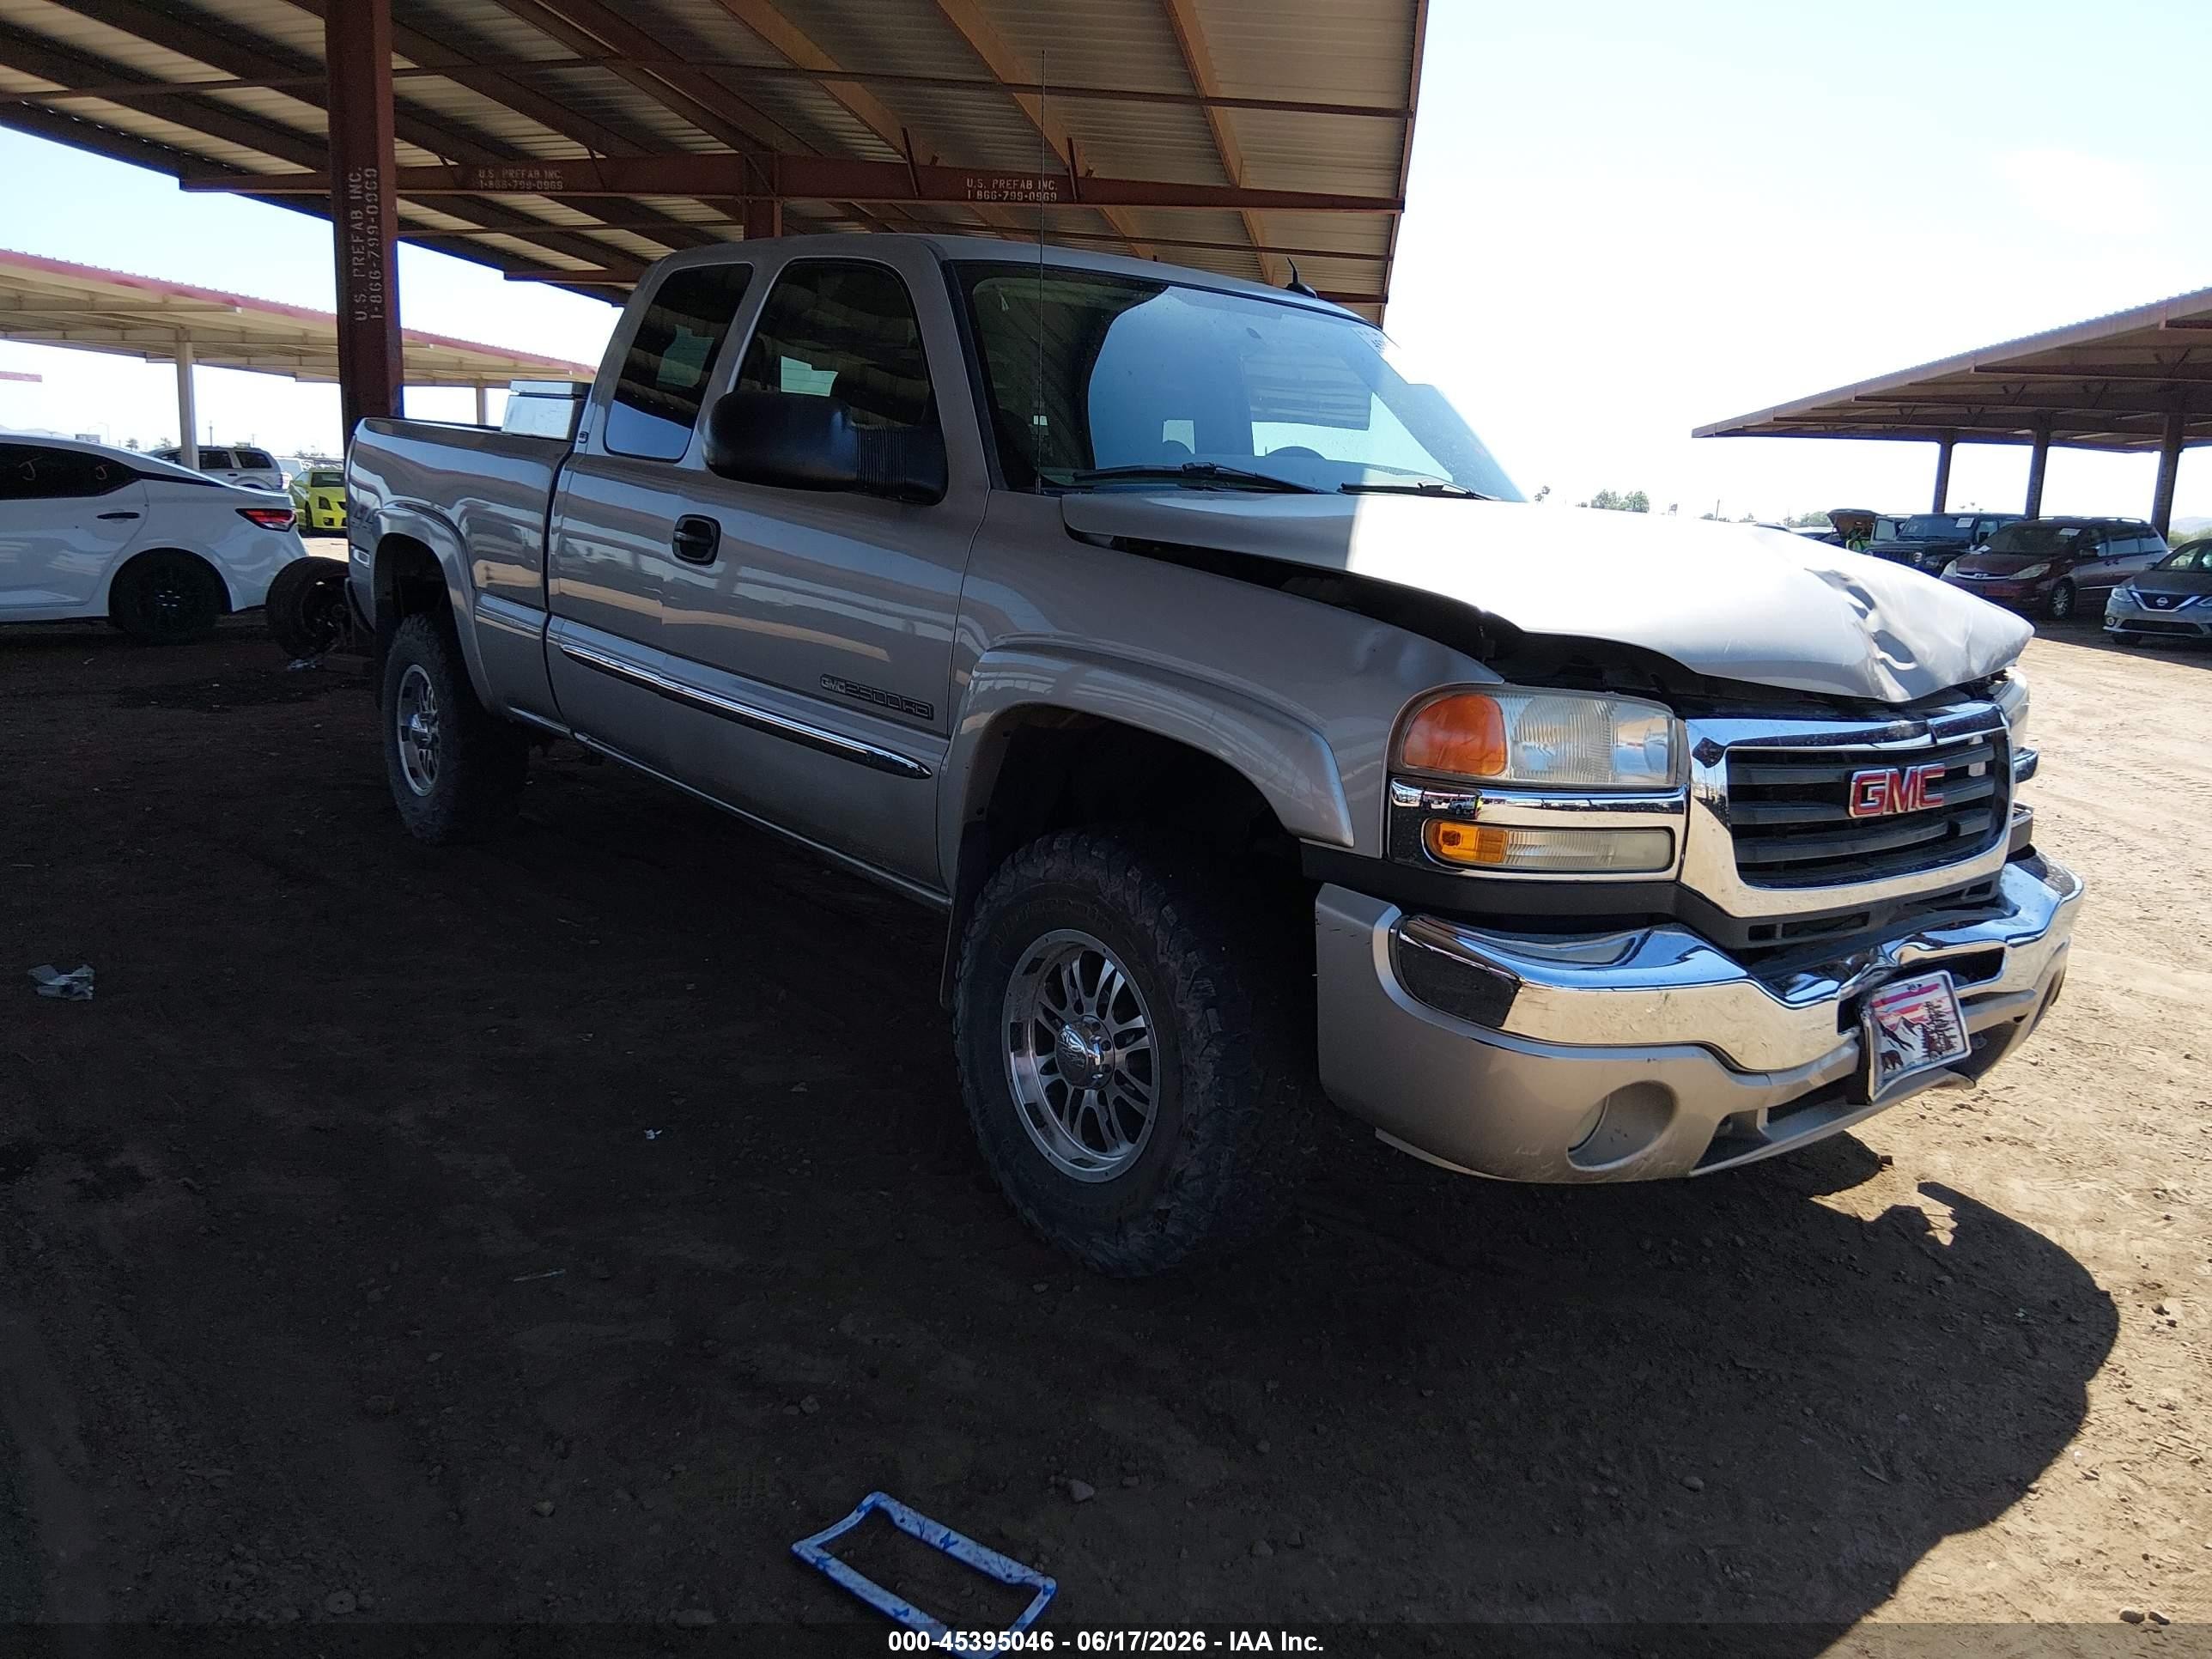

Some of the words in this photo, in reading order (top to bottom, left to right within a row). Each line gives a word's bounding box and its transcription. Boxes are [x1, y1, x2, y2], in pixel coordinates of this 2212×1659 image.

[349, 167, 363, 200] INC.
[502, 168, 540, 179] PREFAB
[966, 178, 988, 189] U.S.
[992, 179, 1034, 190] PREFAB
[1038, 180, 1057, 191] INC.
[350, 210, 366, 277] PREFAB
[364, 167, 383, 319] 1-866-799-0969
[1849, 763, 1946, 818] GMC
